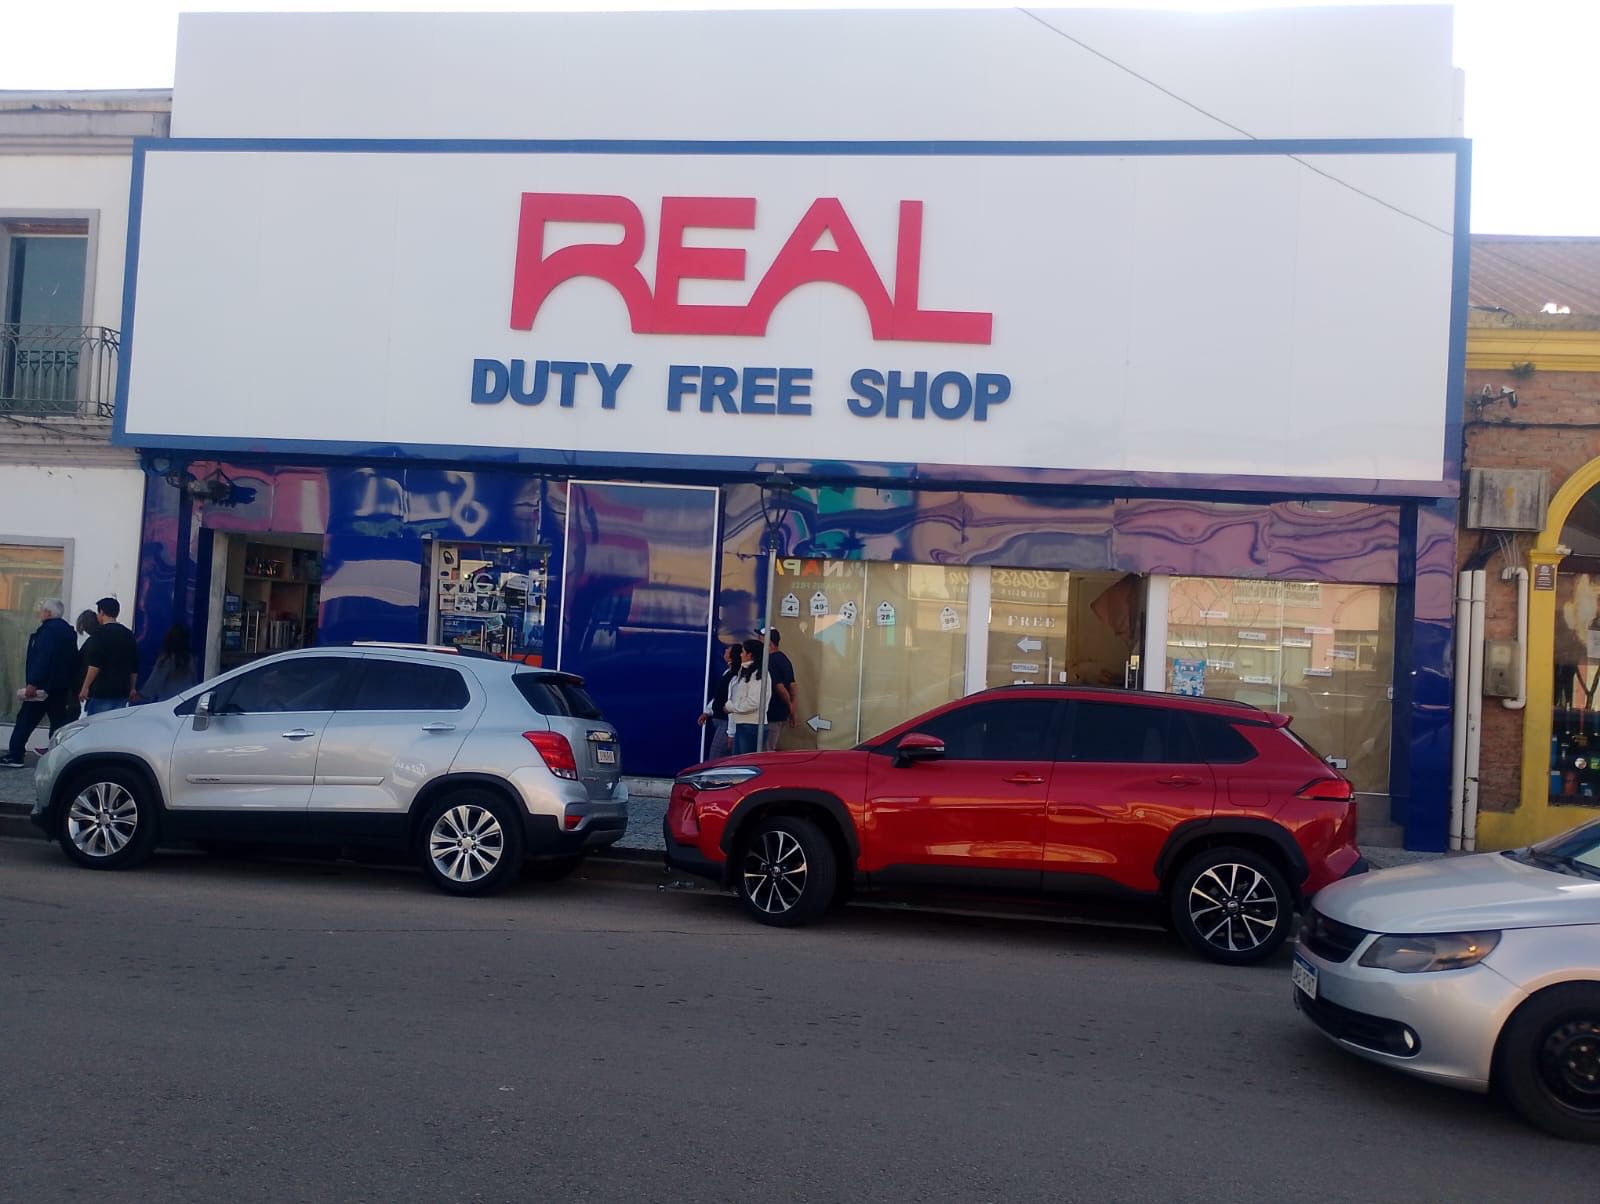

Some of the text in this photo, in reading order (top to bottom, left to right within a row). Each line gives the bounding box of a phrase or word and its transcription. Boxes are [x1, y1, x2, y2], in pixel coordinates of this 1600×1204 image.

[510, 192, 992, 345] REAL
[471, 358, 1011, 421] DUTY FREE SHOP
[1007, 615, 1055, 628] FREE
